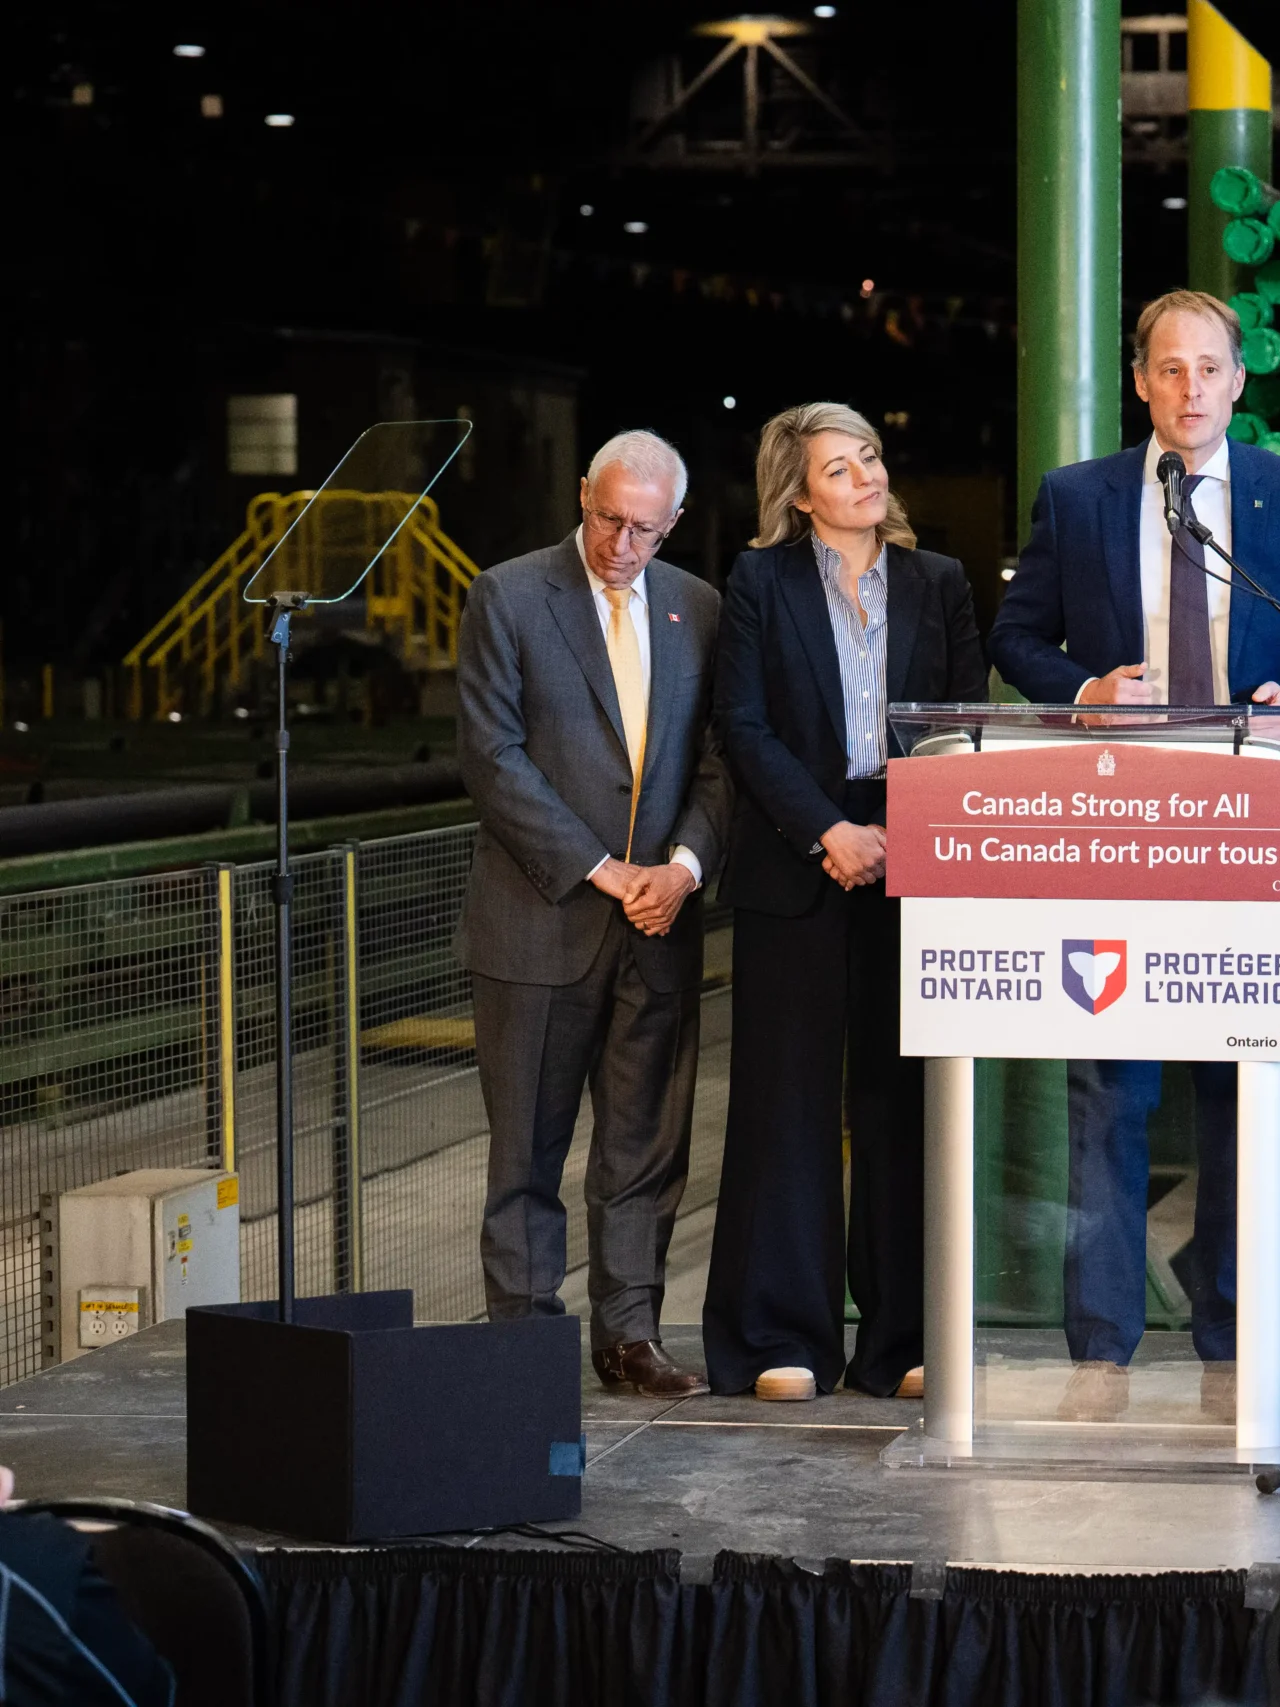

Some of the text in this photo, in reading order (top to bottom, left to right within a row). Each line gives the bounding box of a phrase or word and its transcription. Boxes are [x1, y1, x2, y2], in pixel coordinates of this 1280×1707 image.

[962, 790, 1250, 823] Canada Strong for All
[934, 836, 1278, 869] Un Canada fort pour tous
[921, 949, 1046, 973] PROTECT
[920, 977, 1042, 1001] ONTARIO
[1226, 1036, 1278, 1048] Ontario
